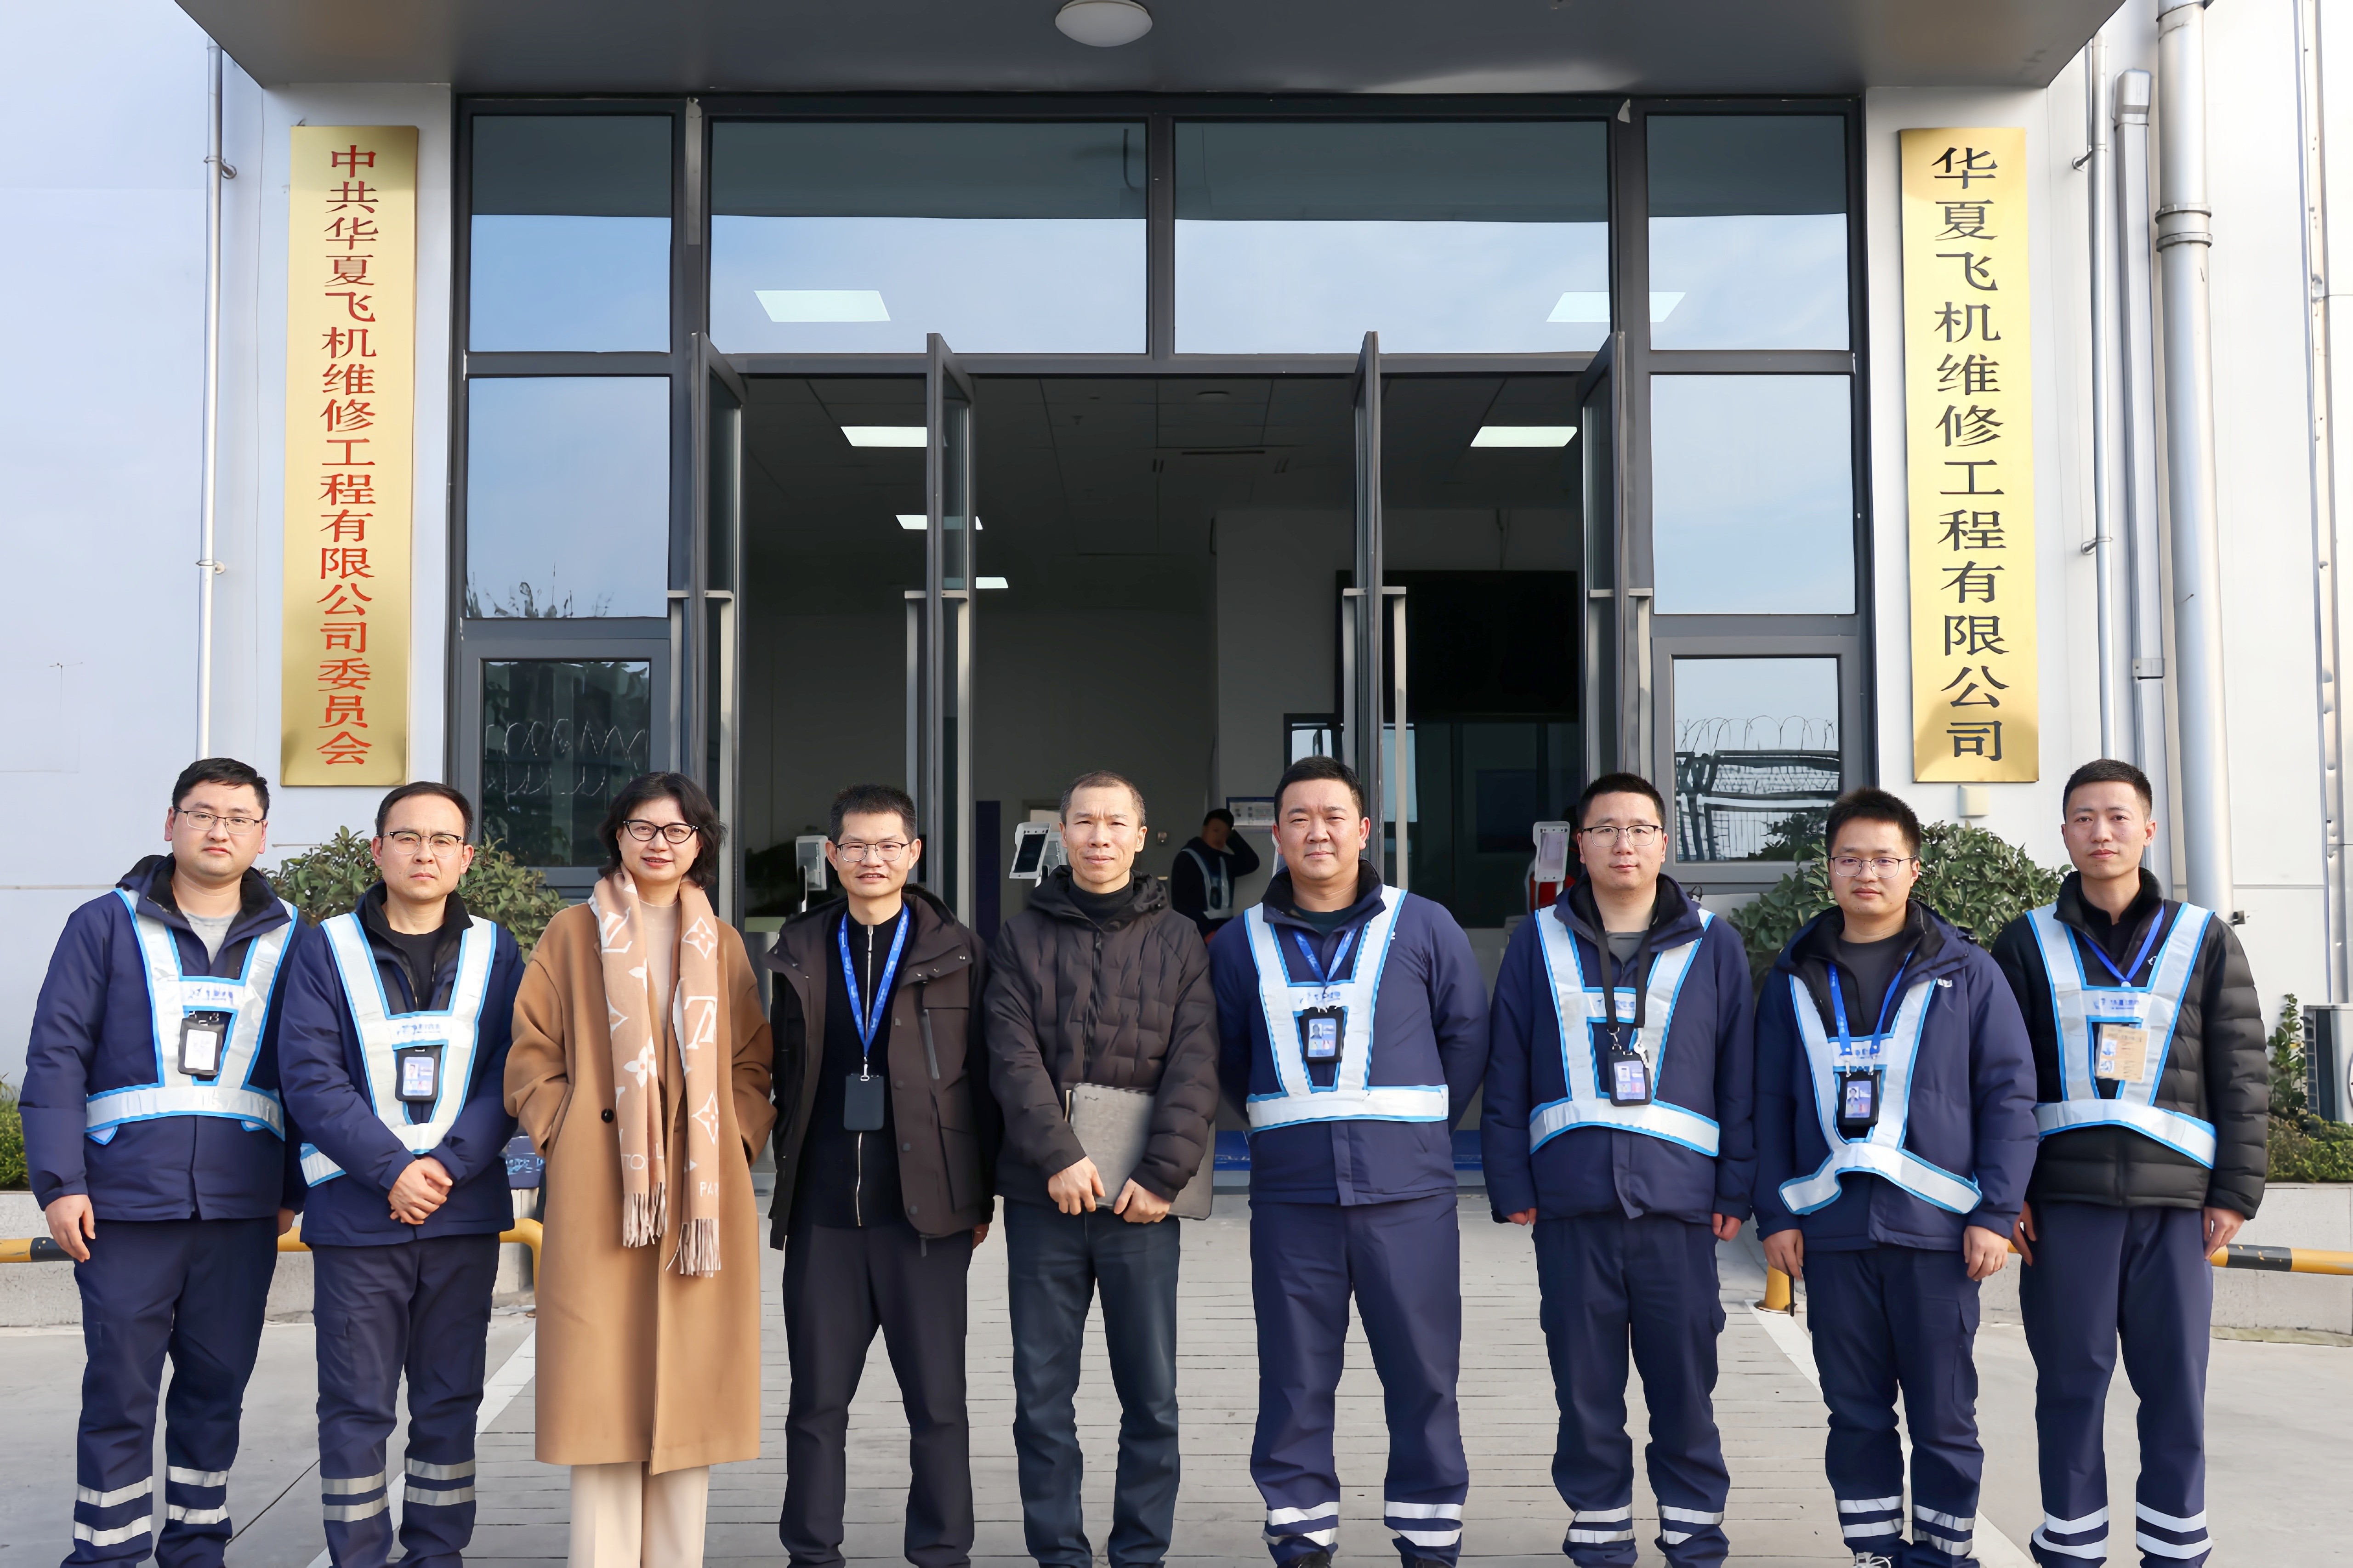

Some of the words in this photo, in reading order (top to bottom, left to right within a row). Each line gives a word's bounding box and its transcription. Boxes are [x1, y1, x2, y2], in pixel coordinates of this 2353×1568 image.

[316, 144, 378, 766] 中共华夏飞机维修工程有限公司委员会
[1931, 147, 2010, 761] 华夏飞机维修工程有限公司
